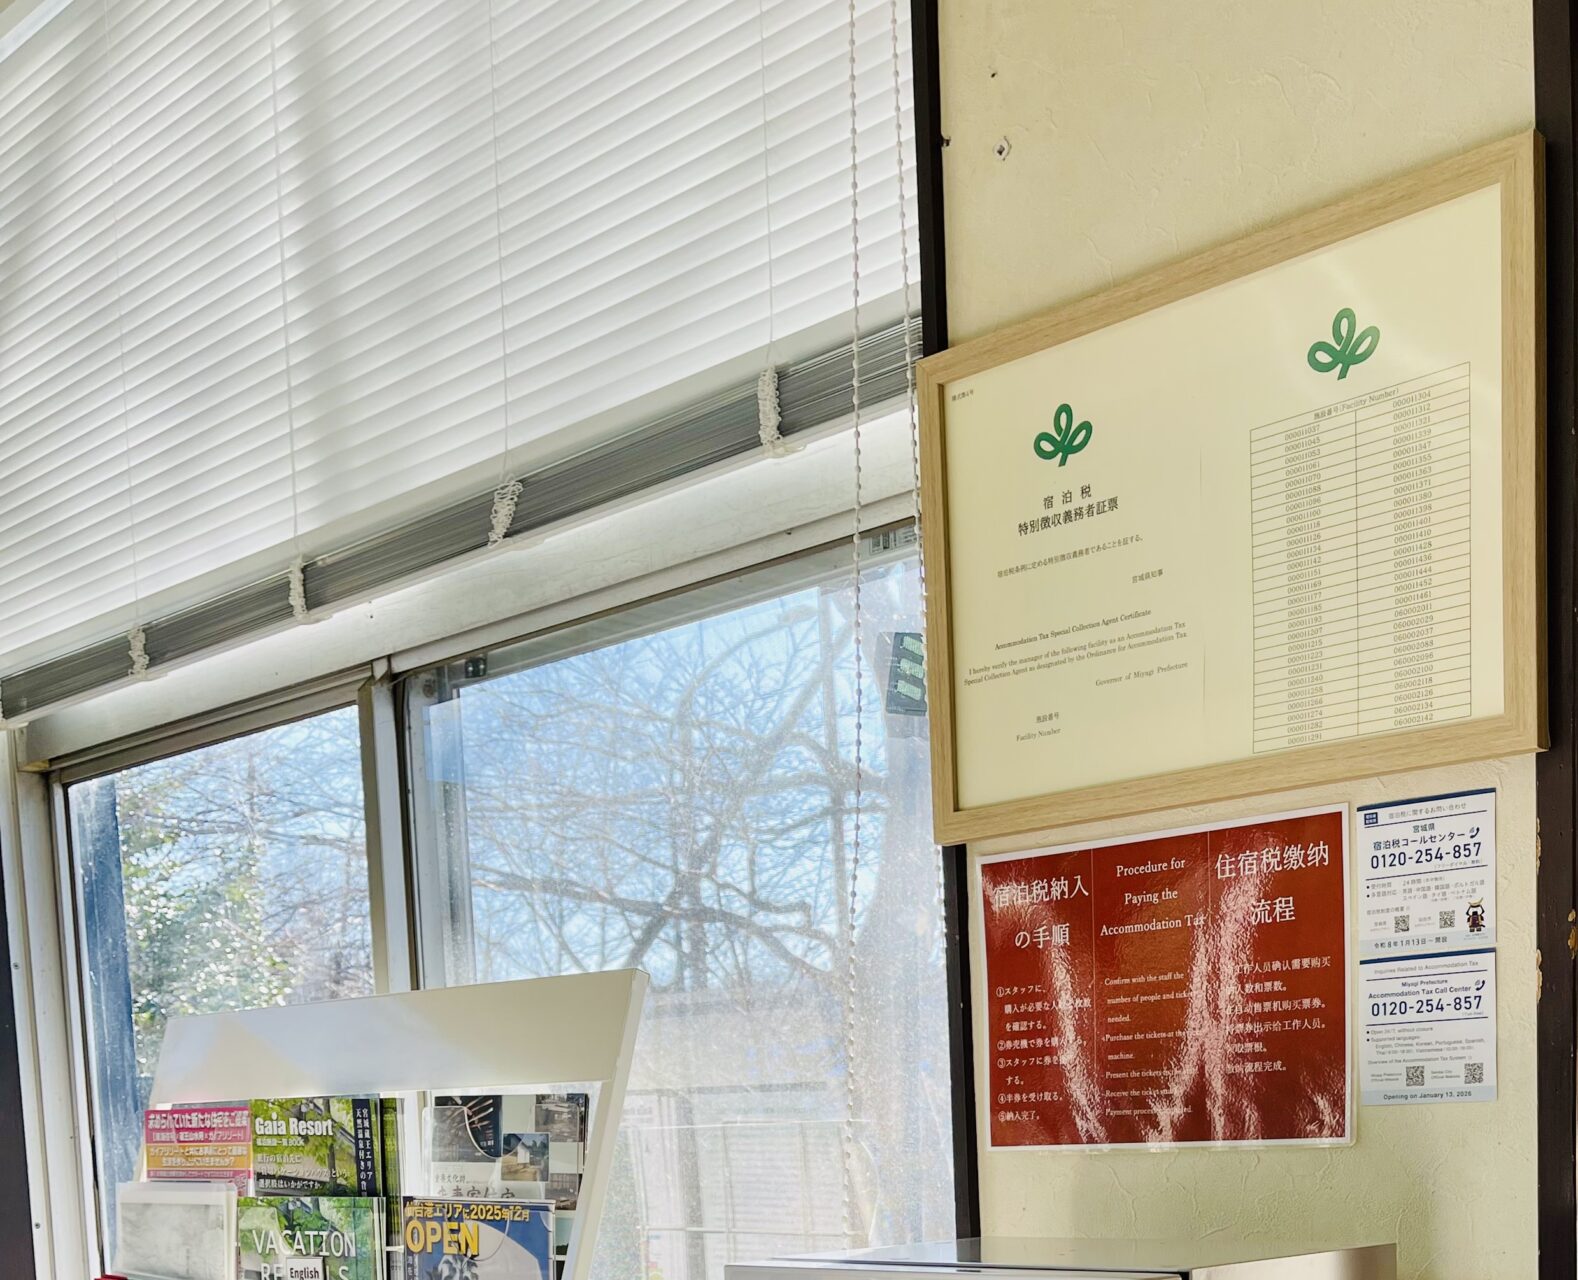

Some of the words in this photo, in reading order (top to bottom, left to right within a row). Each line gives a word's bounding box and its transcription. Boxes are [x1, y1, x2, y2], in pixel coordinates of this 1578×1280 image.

[1392, 390, 1431, 408] 000011304
[1393, 403, 1431, 420] 000011312
[1393, 441, 1431, 458] 000011347
[1393, 466, 1432, 483] 000011363
[1043, 484, 1092, 510] 宿泊税
[1018, 496, 1119, 537] 特別徴収義務者証票
[1394, 516, 1431, 532] 000011401
[1394, 565, 1432, 581] 000011444
[1394, 603, 1432, 618] 060002011
[995, 635, 1038, 651] Accommodation
[1039, 632, 1049, 641] Tax
[1050, 627, 1071, 638] Special
[1072, 621, 1100, 633] Collection
[1101, 617, 1119, 627] Agent
[1120, 609, 1152, 622] Certificate
[1393, 627, 1434, 642] 060002037
[1095, 676, 1122, 687] Governor
[1133, 668, 1155, 680] Miyagi
[1157, 661, 1188, 674] Prefecture
[1394, 664, 1434, 678] 060002100
[1394, 713, 1434, 727] 060002142
[1016, 731, 1037, 743] Facility
[1038, 727, 1061, 740] Number
[1412, 823, 1435, 834] 宮城県
[1373, 831, 1466, 851] 宿泊税コールセンター
[1214, 841, 1329, 880] 住宿税缴纳
[1371, 841, 1482, 869] 0120-254-857
[1116, 858, 1168, 878] Procedure
[1170, 857, 1186, 872] for
[993, 874, 1089, 908] 宿泊税納入
[1124, 889, 1158, 906] Paying
[1161, 887, 1178, 902] the
[1250, 896, 1296, 925] 流程
[1100, 917, 1182, 937] Accommodation
[1184, 914, 1206, 928] Tax
[1015, 923, 1070, 949] の手順
[1105, 976, 1131, 986] Confirm
[1132, 975, 1146, 984] with
[1159, 972, 1172, 981] staff
[1107, 994, 1131, 1004] number
[1140, 993, 1161, 1004] people
[1368, 989, 1420, 999] Accommodation
[1449, 985, 1472, 993] Center
[1371, 995, 1482, 1017] 0120-254-857
[1108, 1014, 1131, 1023] needed.
[1106, 1033, 1133, 1042] Purchase
[1146, 1030, 1165, 1039] tickets
[1108, 1051, 1135, 1060] machine.
[1006, 1076, 1024, 1085] する。
[1106, 1070, 1129, 1079] Present
[1105, 1089, 1128, 1098] Receive
[1383, 1092, 1408, 1101] Opening
[1419, 1091, 1444, 1100] January
[1105, 1107, 1132, 1118] Payment
[255, 1112, 287, 1135] Gaia
[289, 1118, 333, 1136] Resort
[252, 1230, 357, 1257] VACATION
[406, 1219, 480, 1257] OPEN
